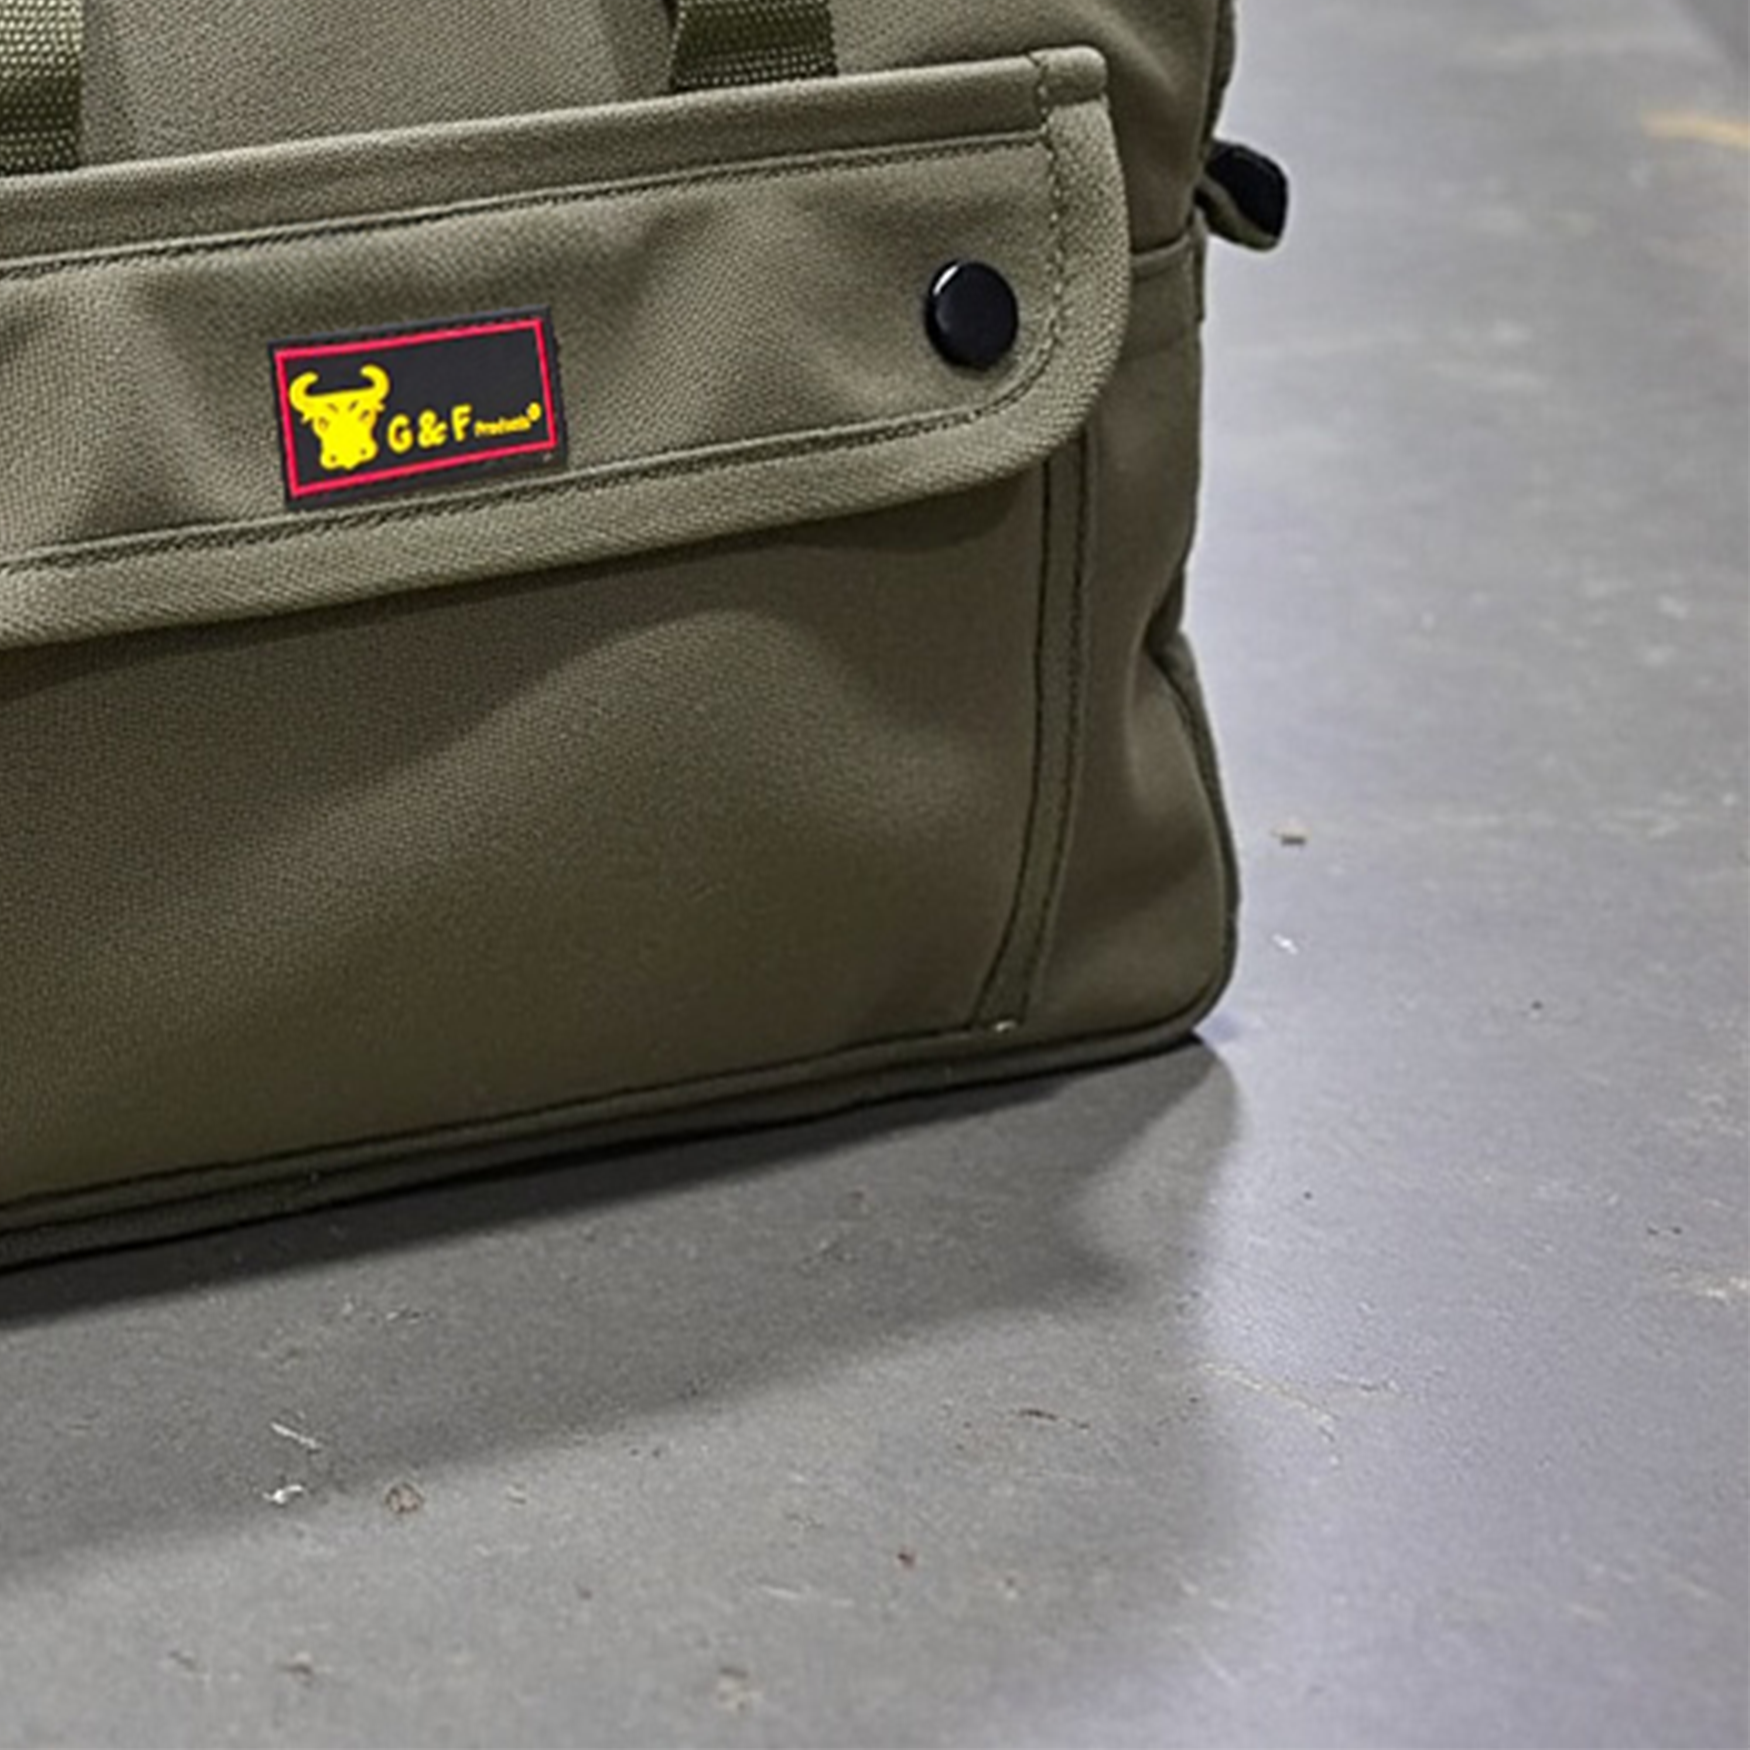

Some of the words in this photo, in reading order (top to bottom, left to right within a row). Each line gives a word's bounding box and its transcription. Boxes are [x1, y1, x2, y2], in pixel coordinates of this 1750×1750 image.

[388, 414, 413, 453] G
[418, 410, 447, 448] &
[452, 404, 472, 441] F
